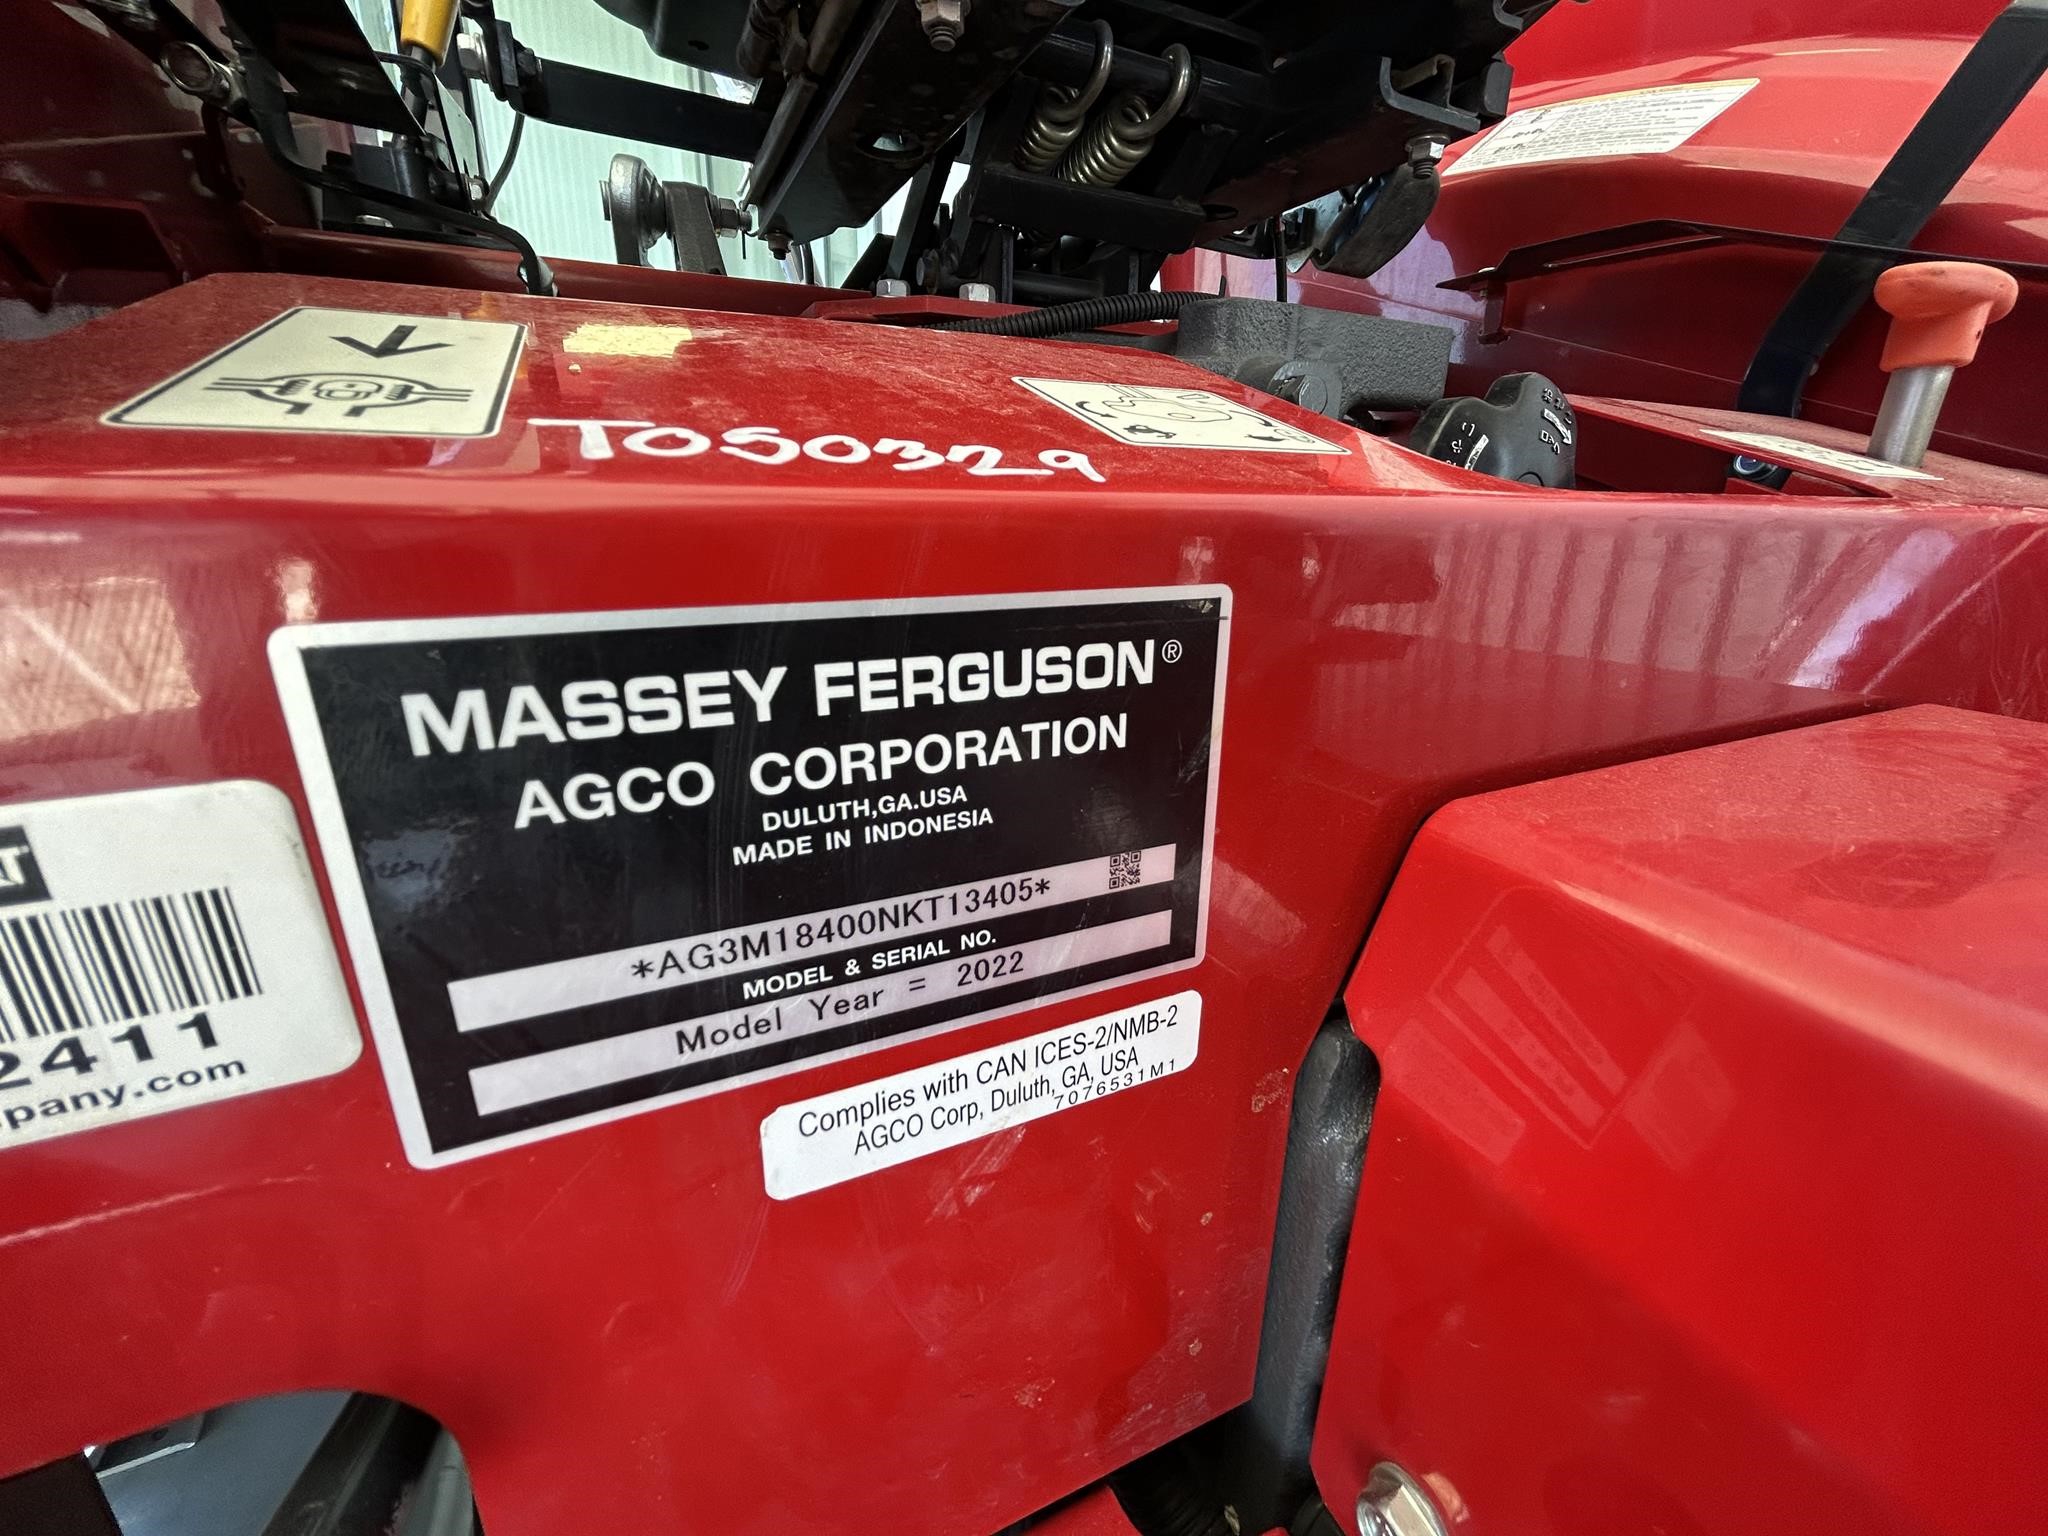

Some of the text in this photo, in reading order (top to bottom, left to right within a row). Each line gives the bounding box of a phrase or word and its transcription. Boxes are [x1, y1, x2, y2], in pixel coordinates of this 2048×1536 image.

[401, 666, 788, 757] MASSEY
[514, 713, 1127, 829] AGCO CORPORATION
[732, 807, 994, 866] MADE IN INDONESIA
[676, 1006, 782, 1055] Model
[808, 987, 884, 1021] Year
[957, 950, 1024, 987] 2022
[743, 928, 997, 999] MODEL & SERIAL NO.
[0, 1060, 246, 1130] pany.com
[799, 1004, 1179, 1138] Complies with CAN ICES-2/NMB-2
[854, 1046, 1139, 1155] AGCO Corp, Duluth, GA, USA
